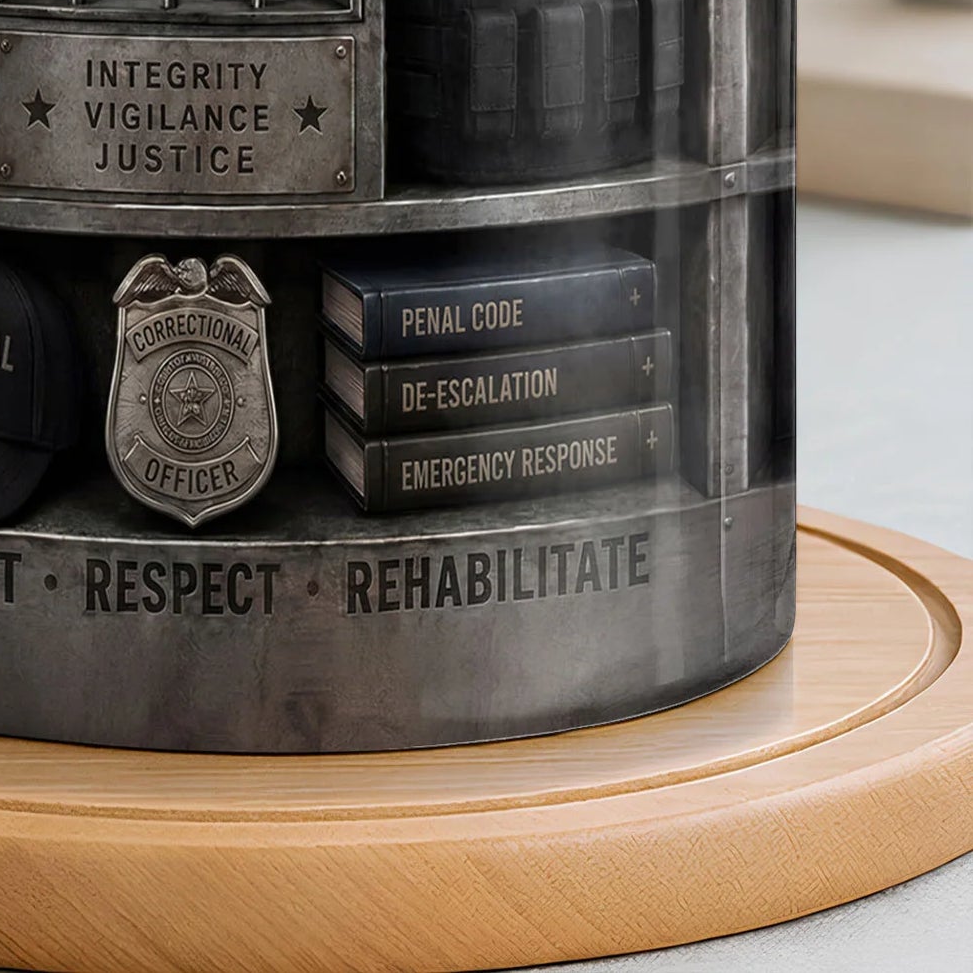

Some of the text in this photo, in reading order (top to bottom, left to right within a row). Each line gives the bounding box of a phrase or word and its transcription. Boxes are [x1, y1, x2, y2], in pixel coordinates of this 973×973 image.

[86, 60, 268, 90] INTEGRITY
[84, 101, 270, 132] VIGILANCE
[94, 143, 255, 174] JUSTICE
[132, 314, 251, 356] CORRECTIONAL
[402, 299, 523, 337] PENAL CODE
[402, 367, 558, 412] DE-ESCALATION
[145, 458, 239, 494] OFFICER
[402, 436, 617, 491] EMERGENCY RESPONSE
[85, 558, 280, 616] RESPECT
[347, 532, 651, 614] REHABILITATE
